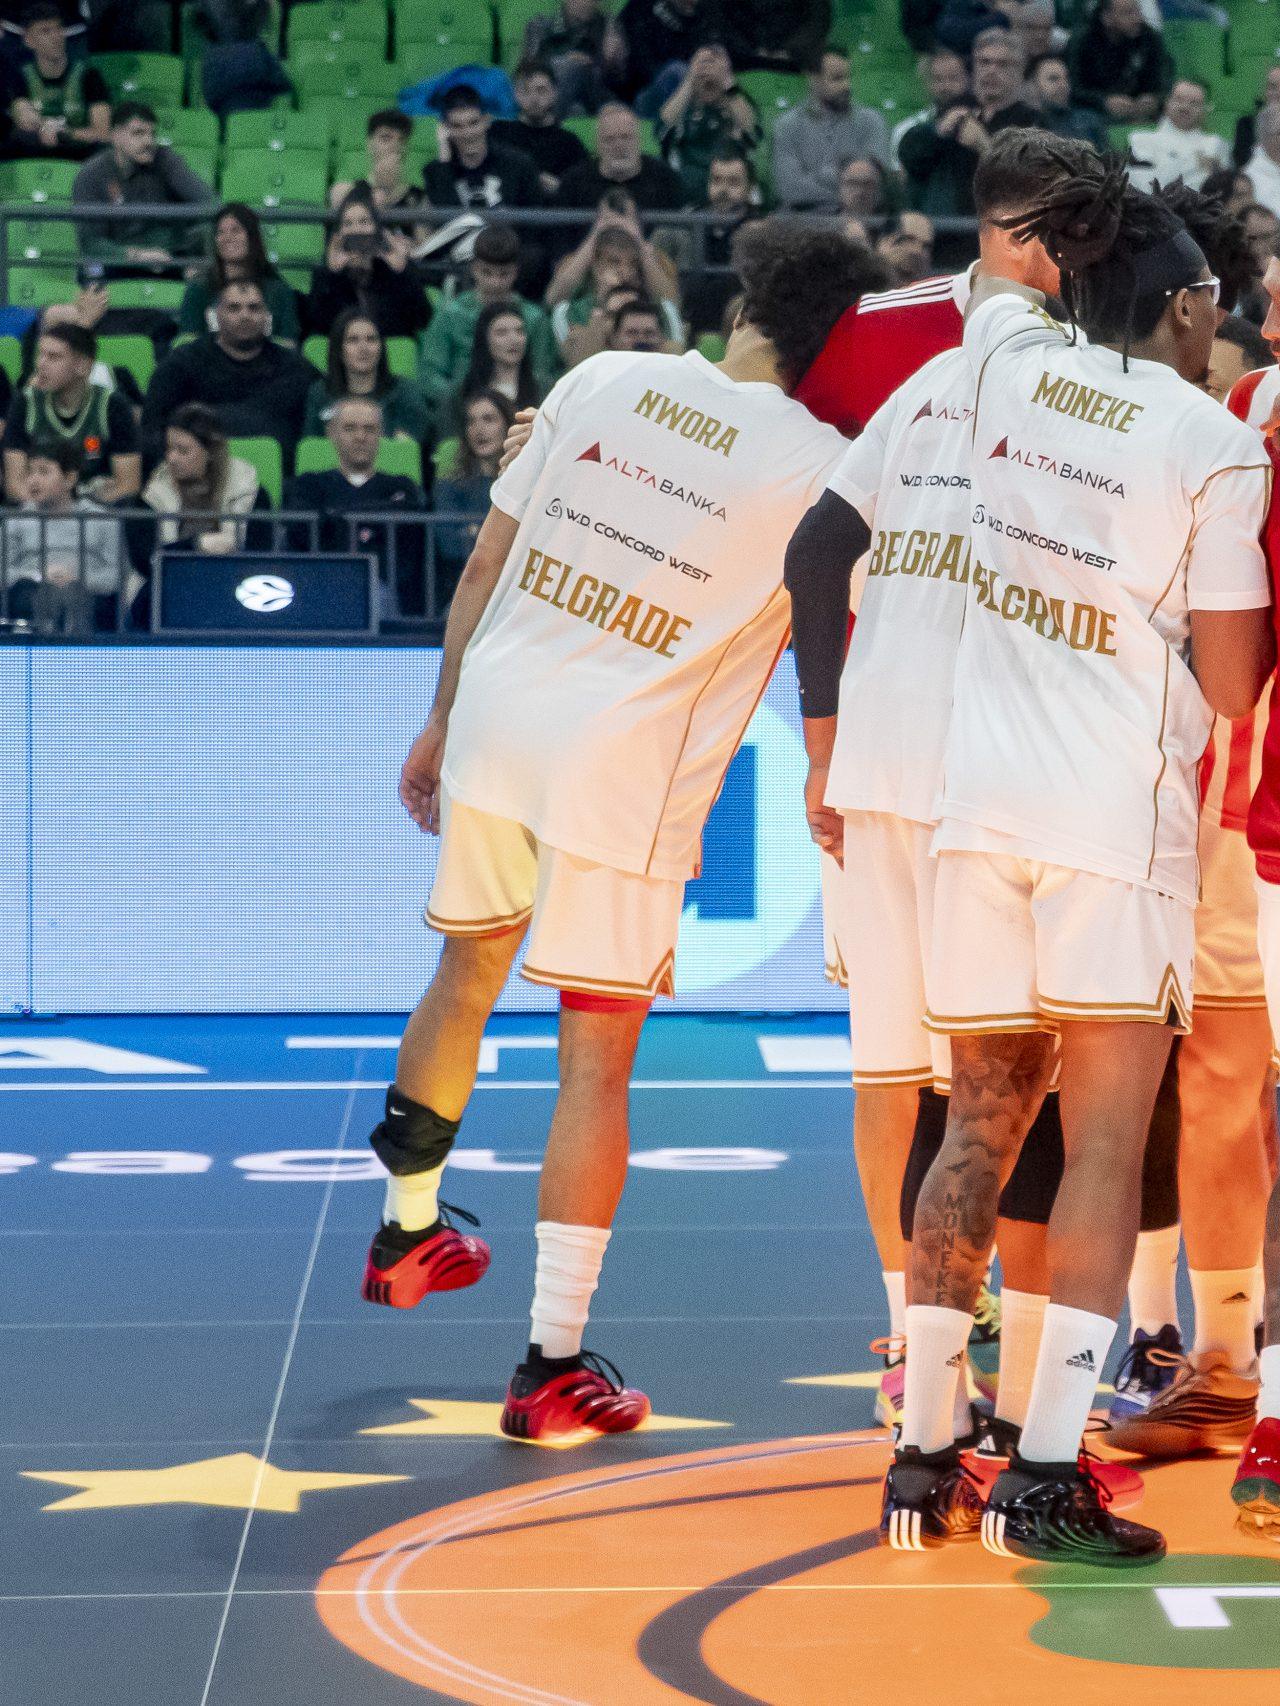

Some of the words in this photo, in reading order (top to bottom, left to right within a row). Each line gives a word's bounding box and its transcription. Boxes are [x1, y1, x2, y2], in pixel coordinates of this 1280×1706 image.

[634, 389, 739, 457] NWORA
[1031, 371, 1144, 434] MONEKE
[594, 522, 666, 562] CONCORD
[669, 556, 713, 583] WEST
[1005, 524, 1068, 556] CONCORD
[1072, 547, 1118, 572] WEST
